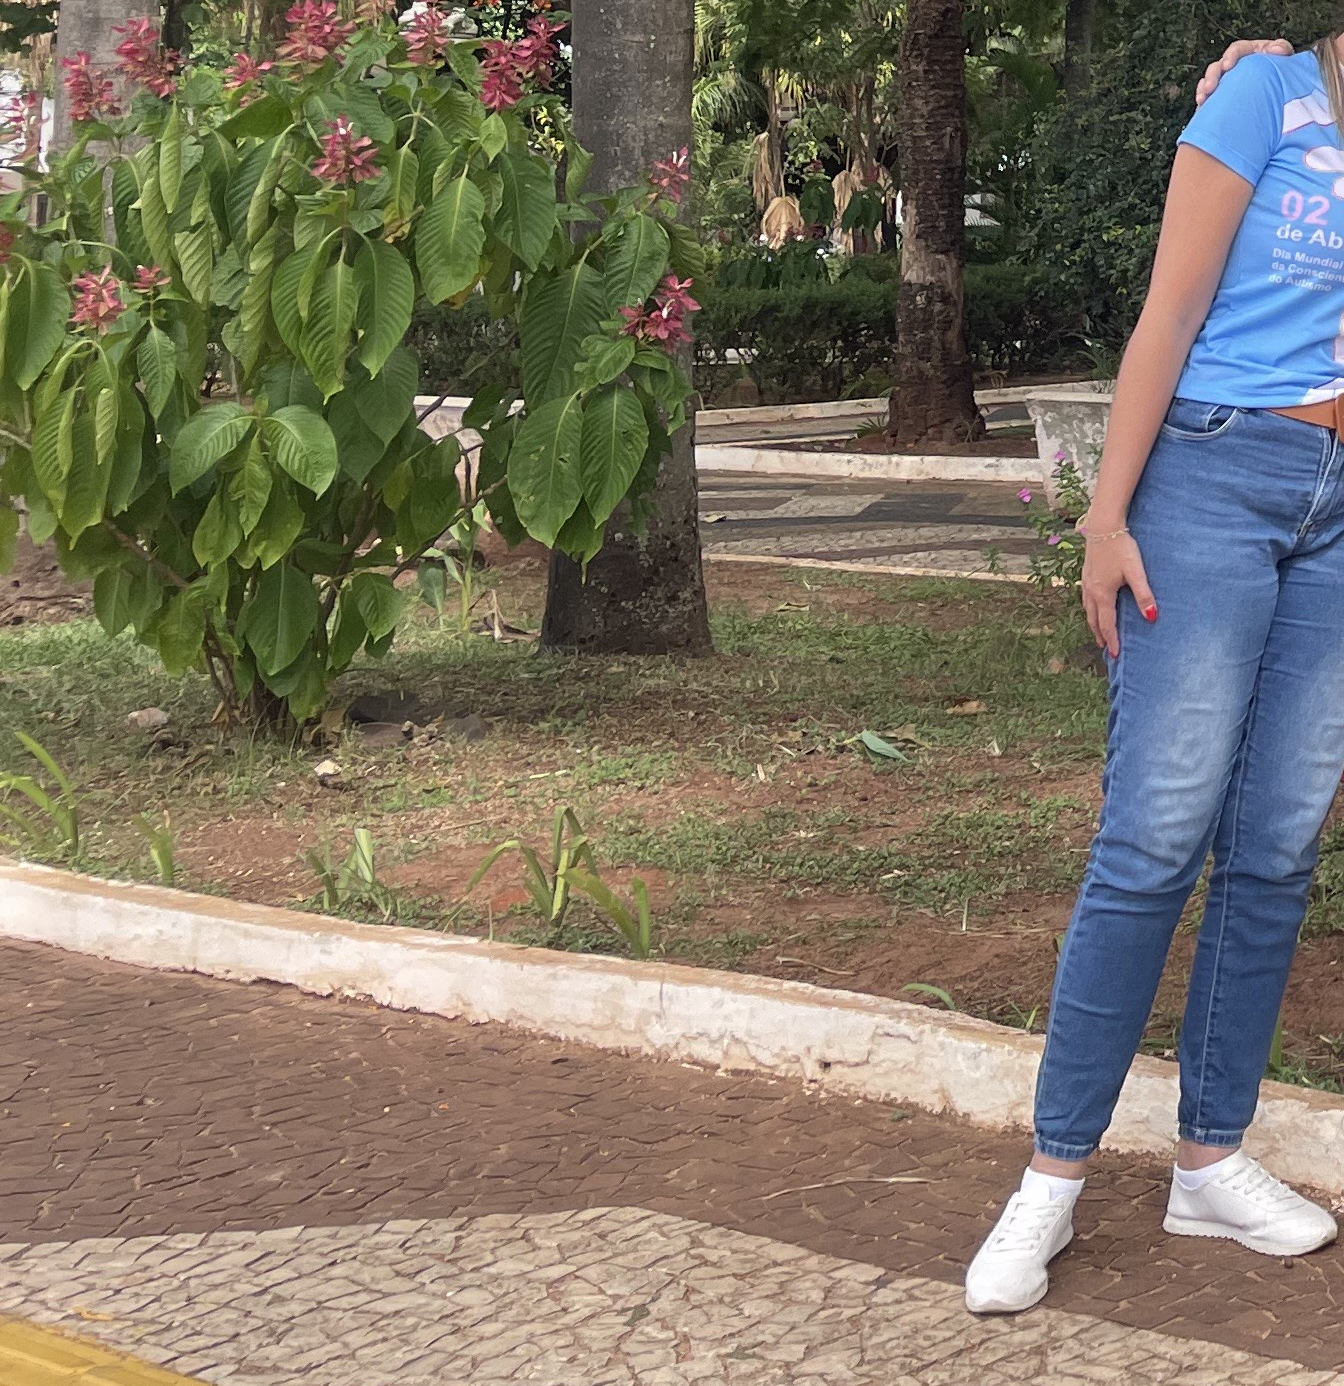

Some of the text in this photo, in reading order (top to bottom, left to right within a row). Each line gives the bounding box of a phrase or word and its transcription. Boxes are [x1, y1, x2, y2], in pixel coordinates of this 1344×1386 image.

[1281, 190, 1331, 226] 02
[1276, 223, 1303, 242] de
[1271, 261, 1285, 271] da
[1272, 248, 1344, 270] Dia Mundial
[1268, 274, 1332, 292] do Autismo
